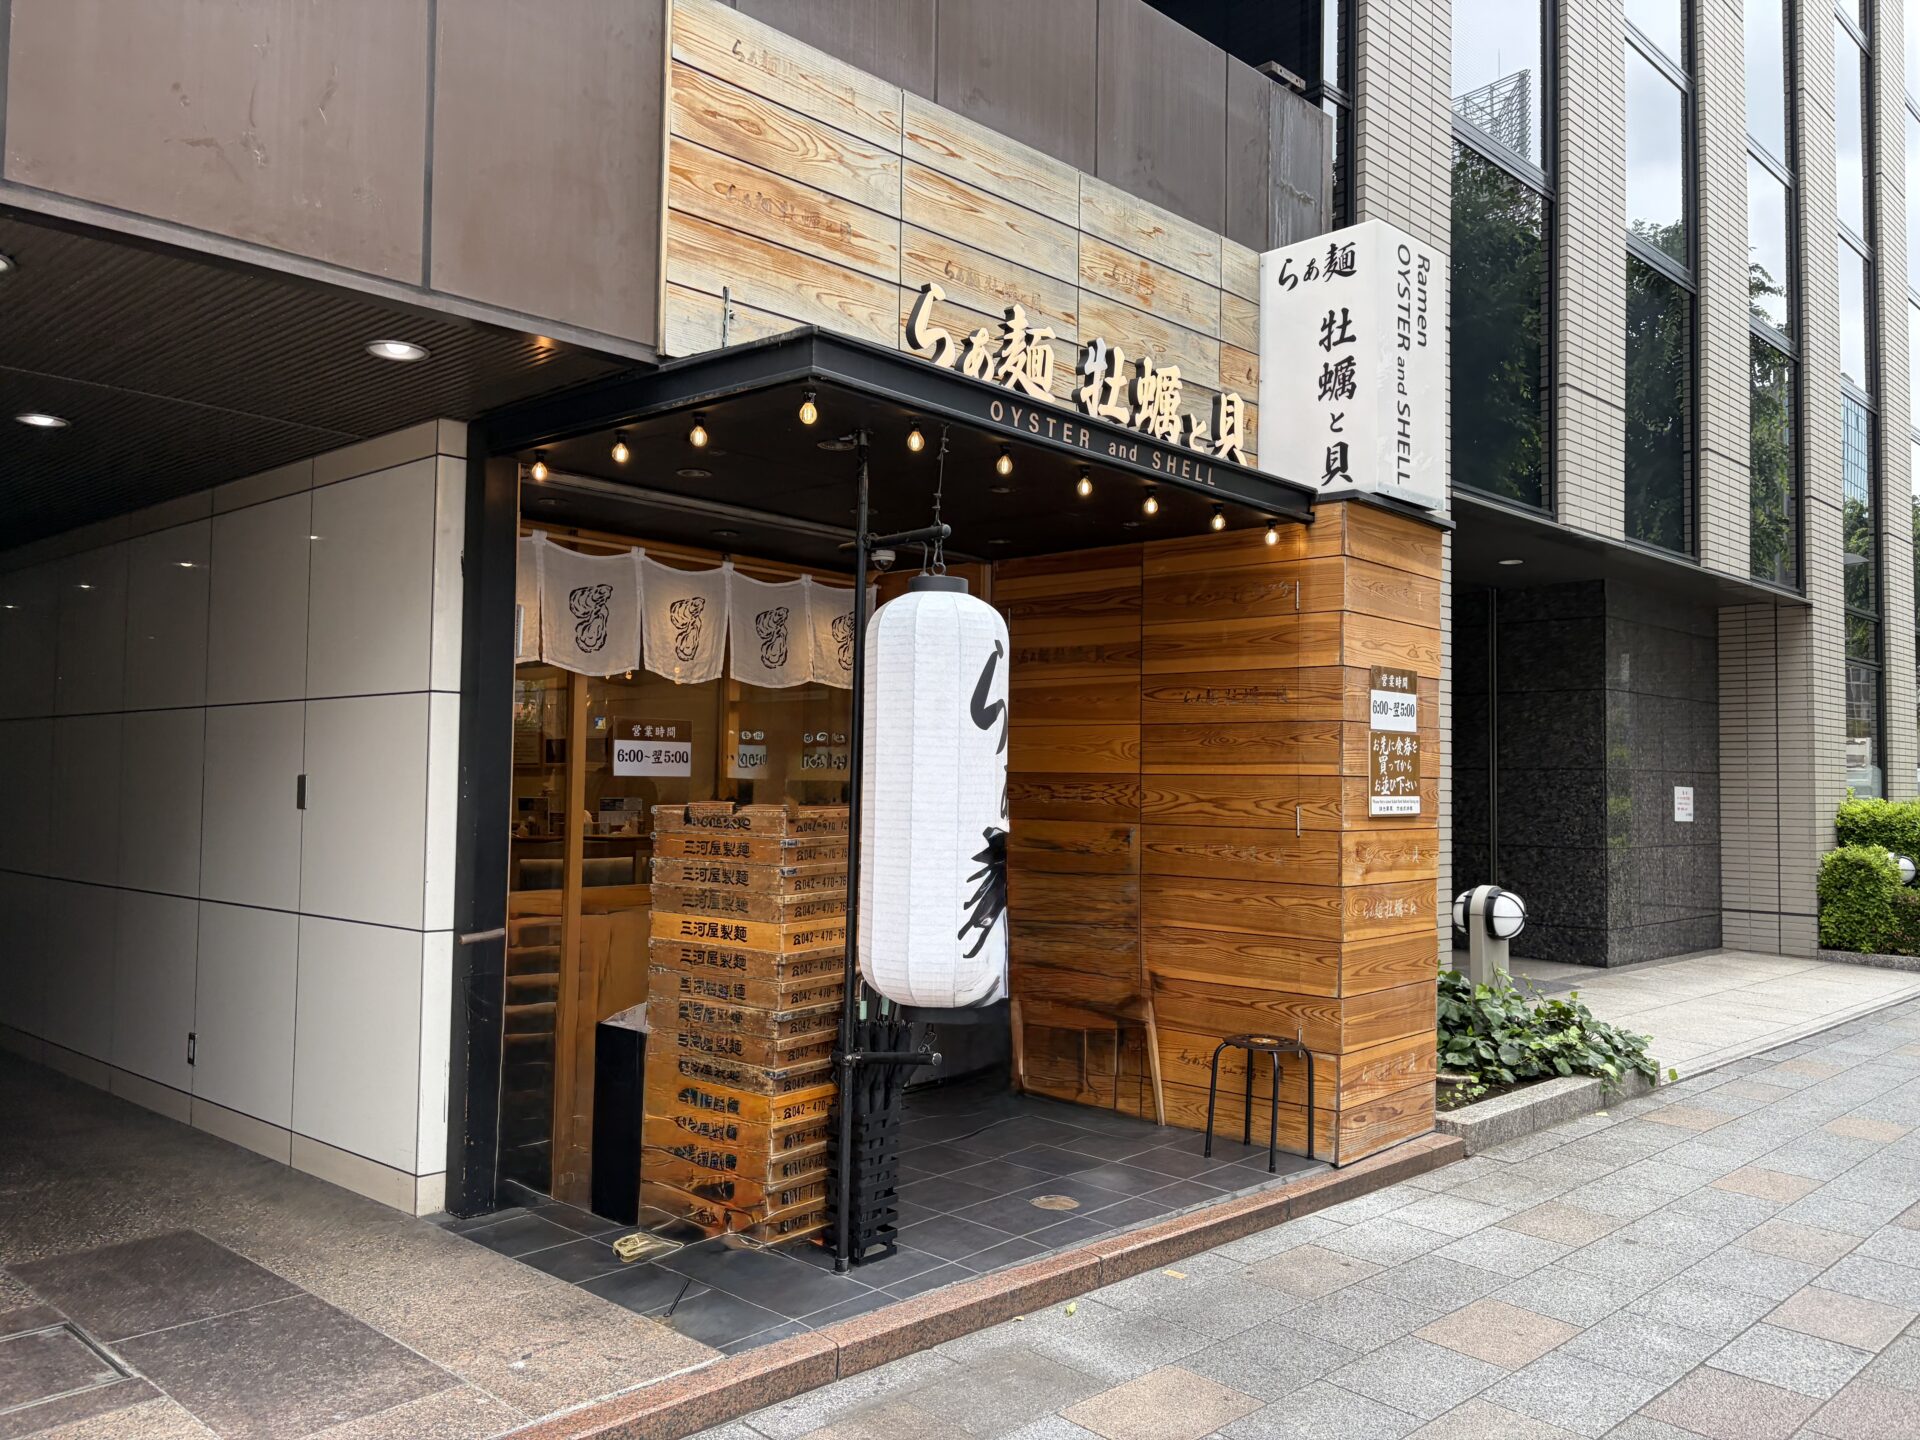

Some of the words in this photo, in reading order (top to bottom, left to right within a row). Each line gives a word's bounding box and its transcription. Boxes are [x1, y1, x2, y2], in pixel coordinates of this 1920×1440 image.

[1278, 241, 1358, 292] らぁ麺
[1397, 243, 1411, 351] OYSTER
[1417, 252, 1431, 347] Ramen
[1397, 355, 1408, 396] and
[1318, 306, 1357, 487] 牡蠣と貝
[990, 400, 1090, 449] OYSTER
[1108, 440, 1138, 463] and
[1152, 451, 1216, 486] SHELL
[1397, 400, 1411, 485] SHELL
[1381, 673, 1409, 690] 営業時間
[631, 724, 676, 739] 営業時間
[1378, 755, 1413, 775] 買ってから
[681, 866, 750, 887] 三河屋製麺
[680, 920, 748, 943] 三河屋製麺
[679, 948, 748, 971] 三河屋製麺
